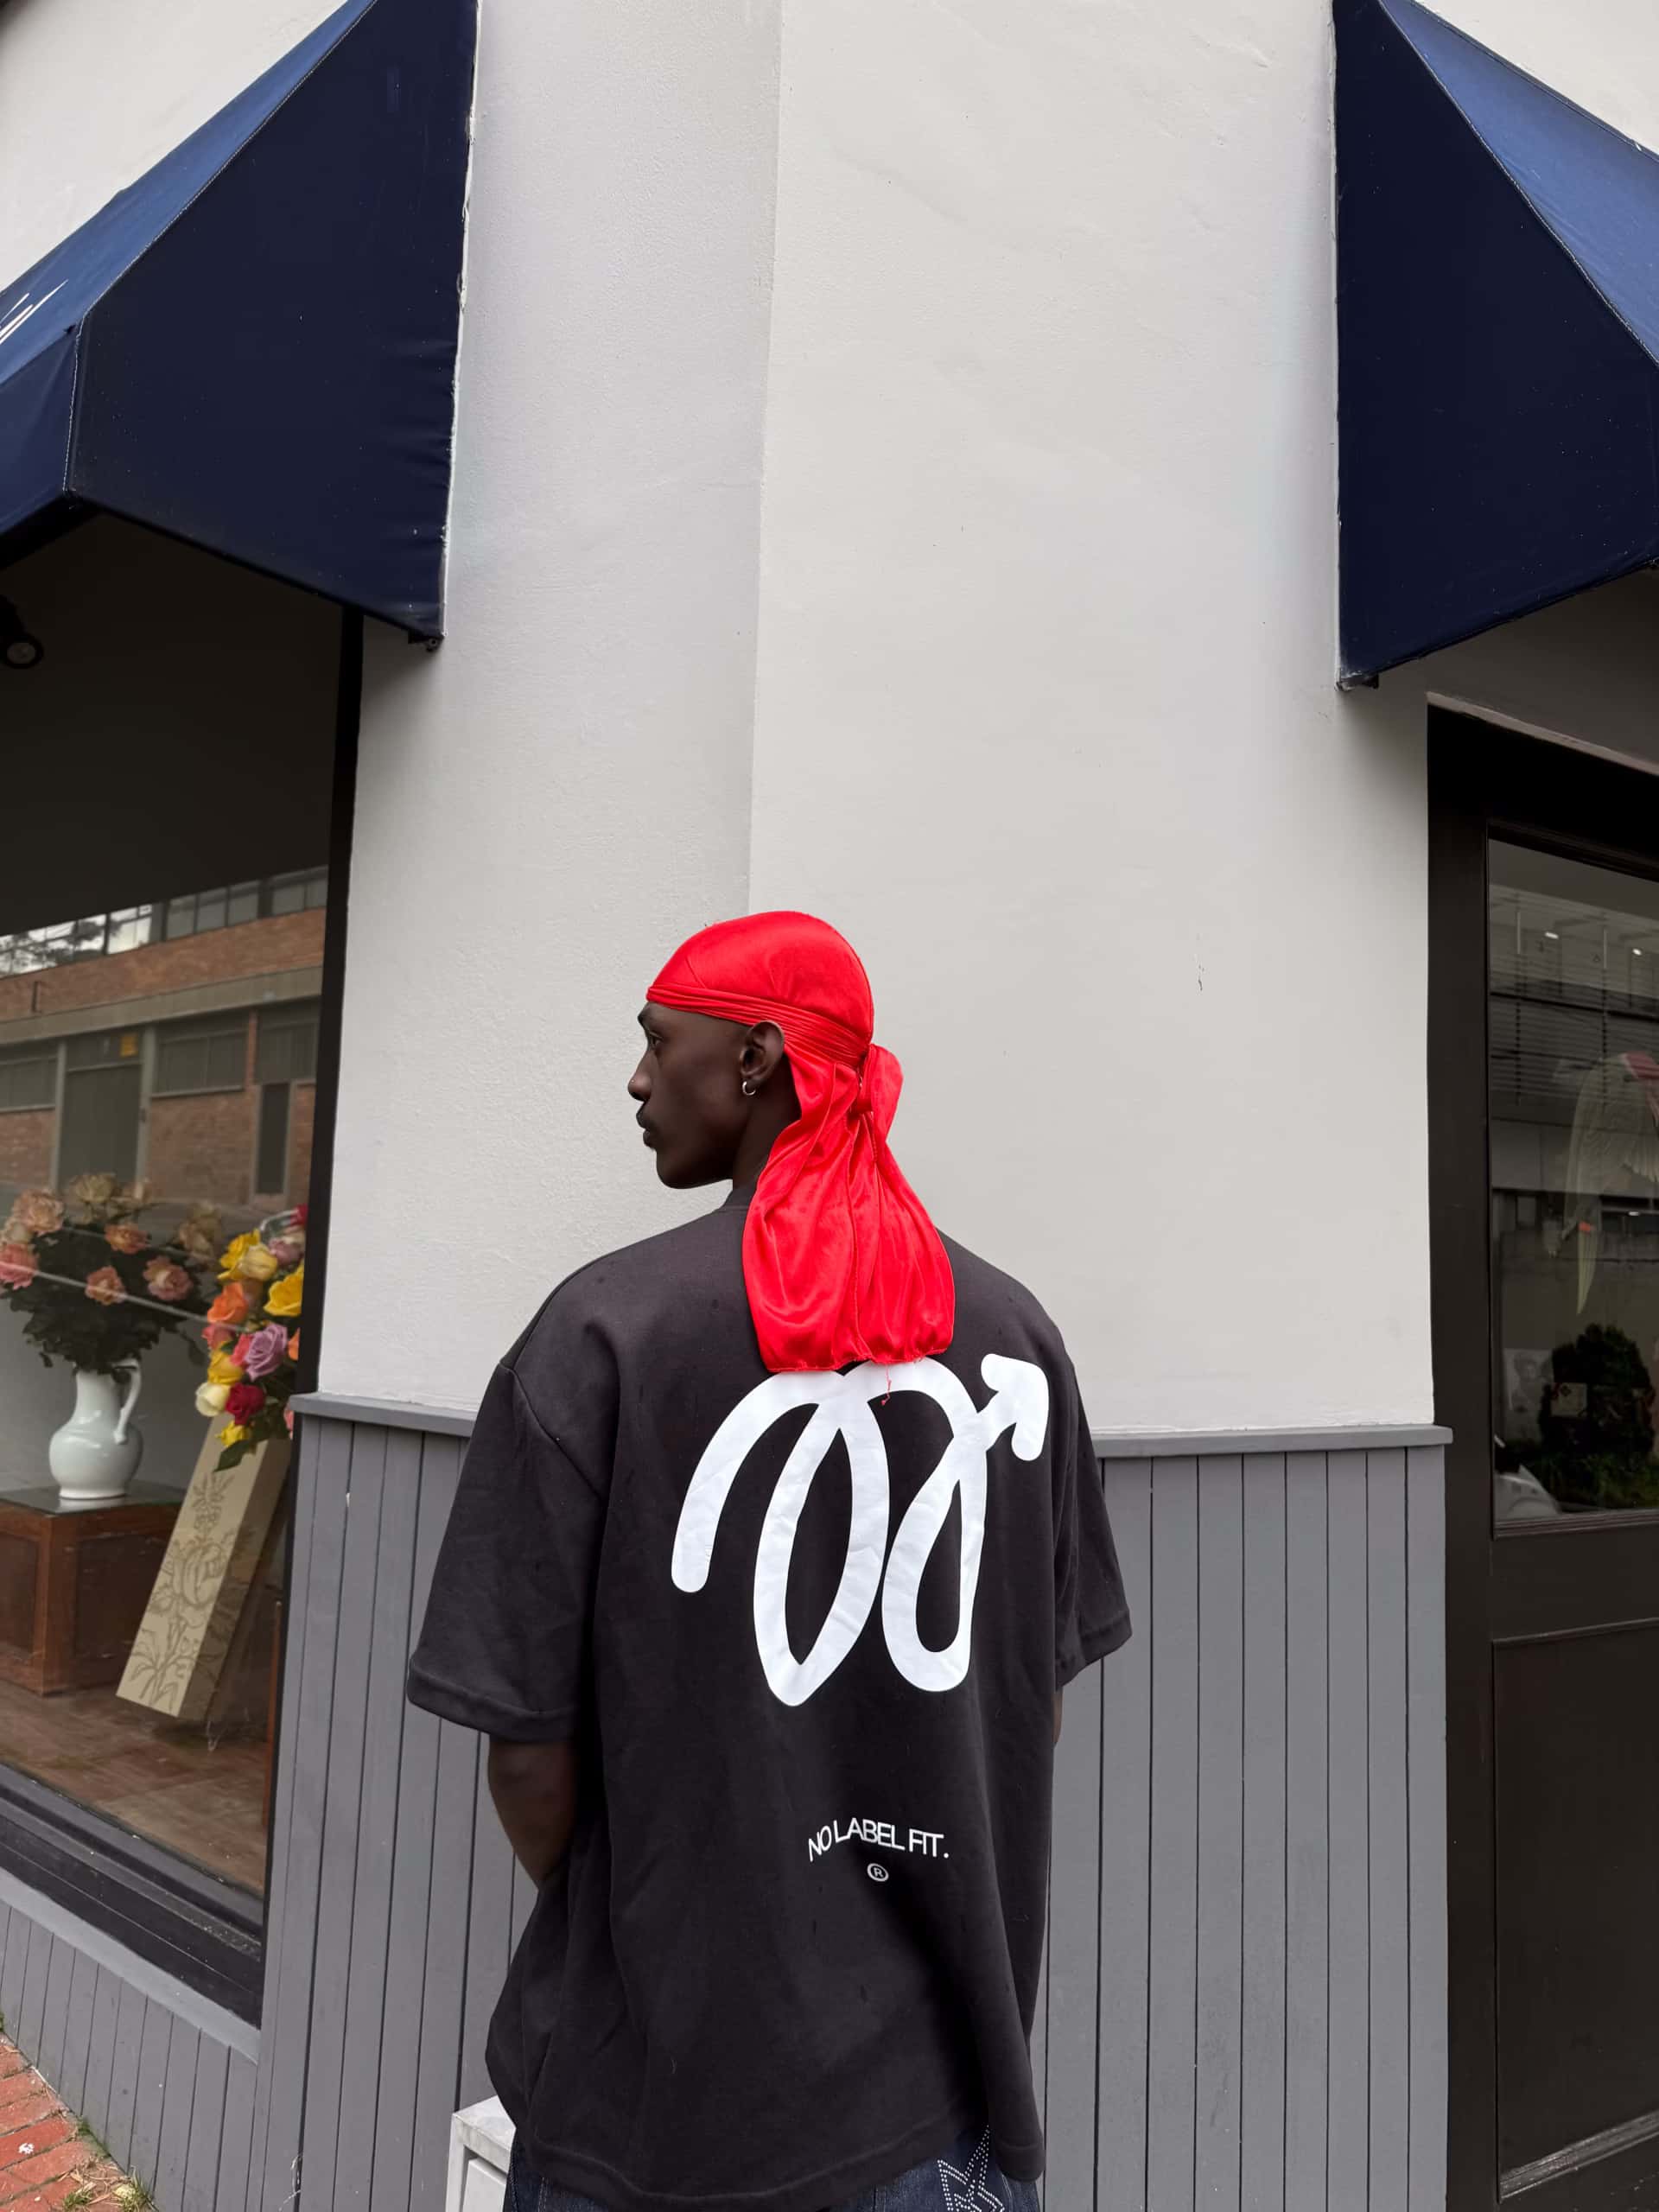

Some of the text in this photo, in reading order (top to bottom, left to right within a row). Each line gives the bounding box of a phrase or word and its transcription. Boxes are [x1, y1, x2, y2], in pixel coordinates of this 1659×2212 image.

[808, 1817, 950, 1862] NO LABEL FIT.
